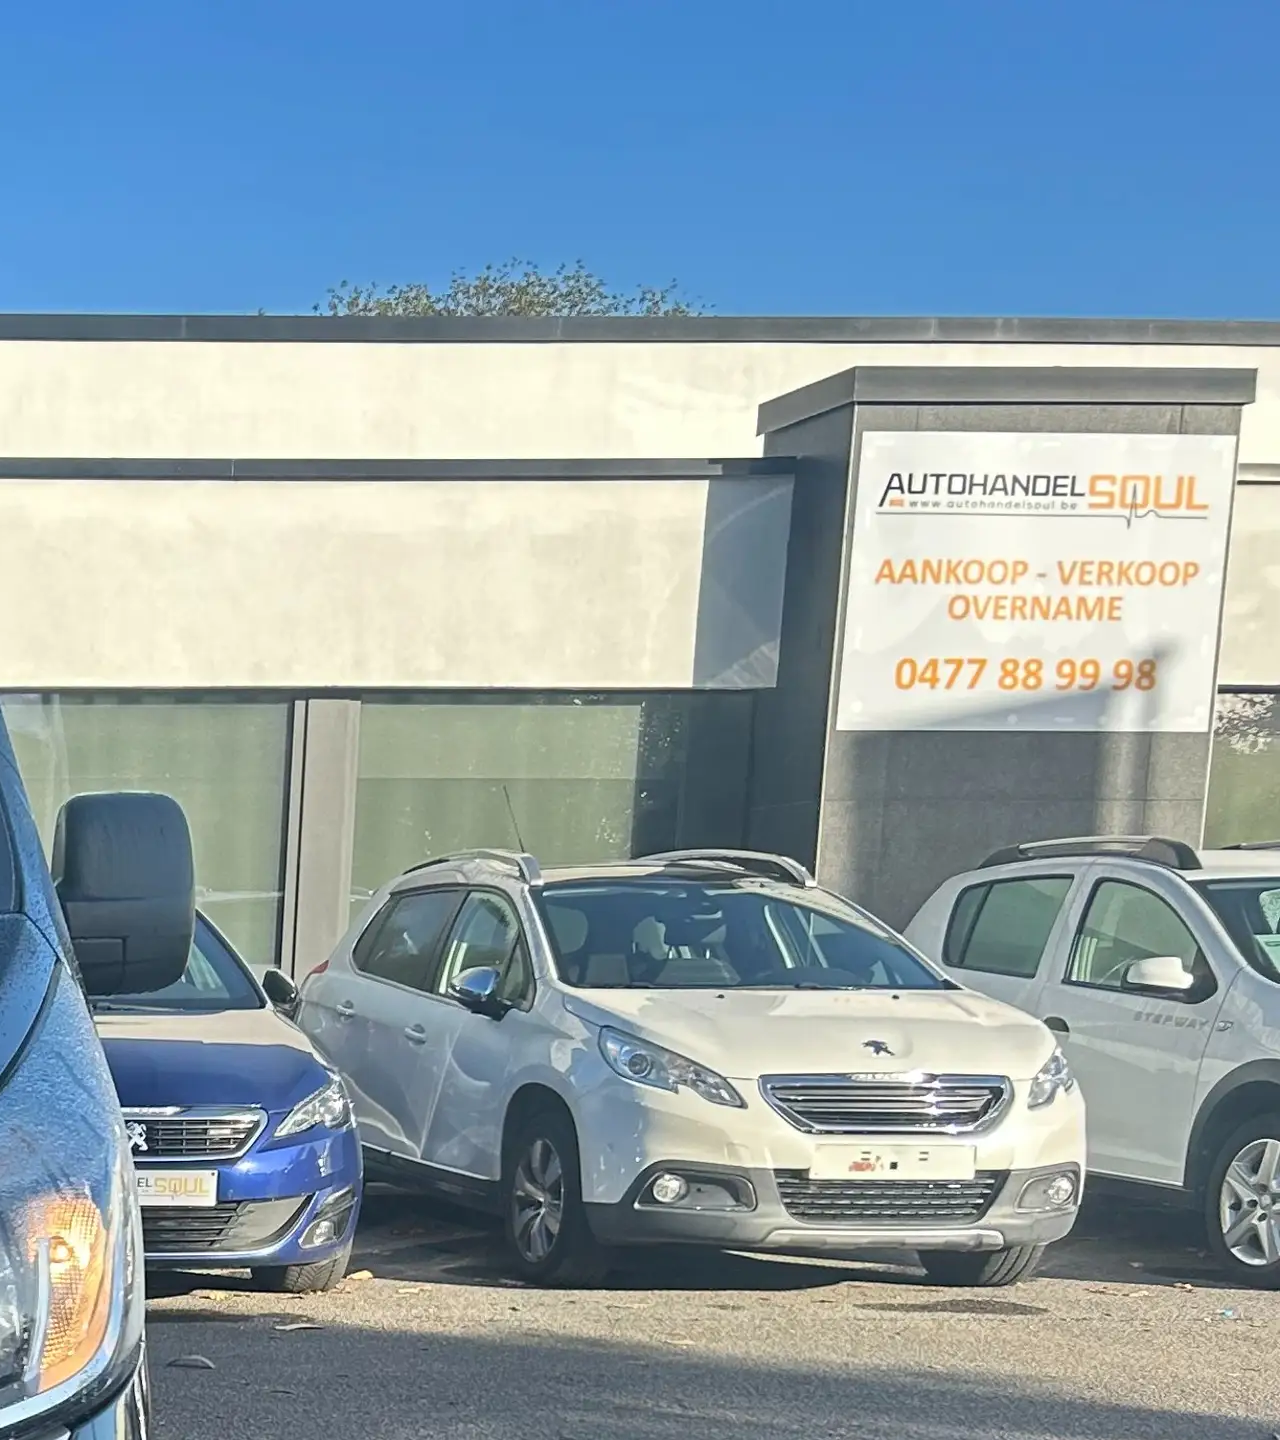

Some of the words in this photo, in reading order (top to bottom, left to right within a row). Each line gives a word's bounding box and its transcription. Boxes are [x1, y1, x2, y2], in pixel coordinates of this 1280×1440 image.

[874, 558, 1029, 586] AANKOOP
[1056, 560, 1200, 587] VERKOOP
[947, 595, 1124, 622] OVERNAME
[894, 657, 987, 691] 0477
[997, 658, 1043, 692] 88
[1055, 658, 1100, 692] 99
[1111, 659, 1157, 692] 98
[1133, 1010, 1210, 1030] STEPWAY
